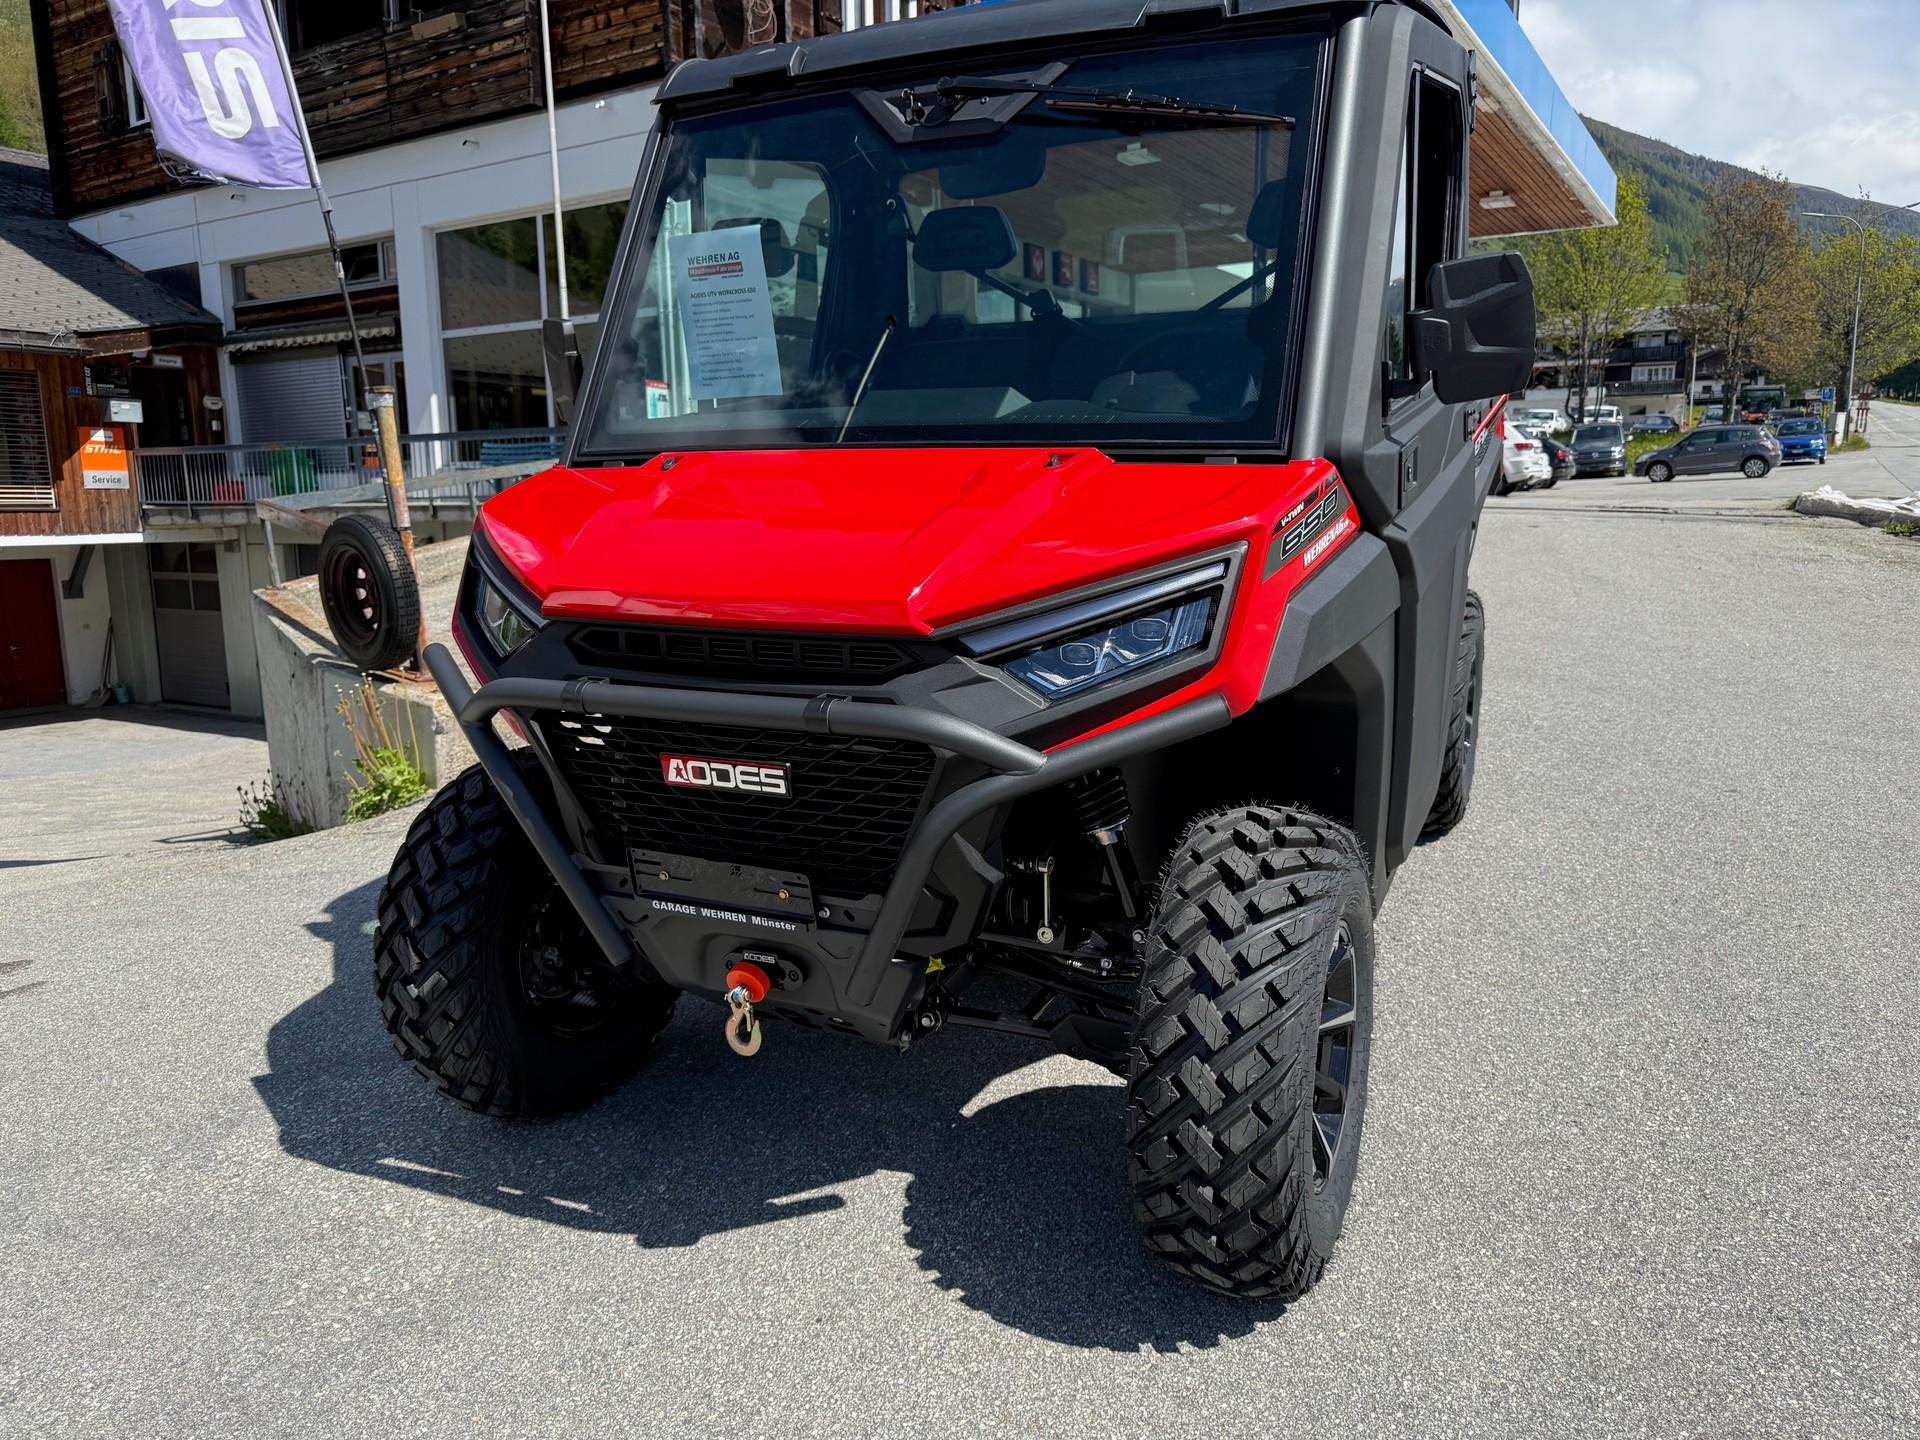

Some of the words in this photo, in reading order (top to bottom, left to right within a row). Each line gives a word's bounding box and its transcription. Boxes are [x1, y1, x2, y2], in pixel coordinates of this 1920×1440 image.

[687, 252, 726, 265] WEHREN
[728, 251, 740, 261] AG
[84, 444, 122, 454] STIHL
[92, 475, 122, 484] Service
[1280, 485, 1339, 561] 650
[1281, 501, 1305, 527] V-TWIN
[668, 758, 787, 794] AODES
[652, 899, 697, 915] GARAGE
[701, 907, 747, 923] WEHREN
[752, 916, 796, 931] Münster
[743, 952, 776, 964] AODES
